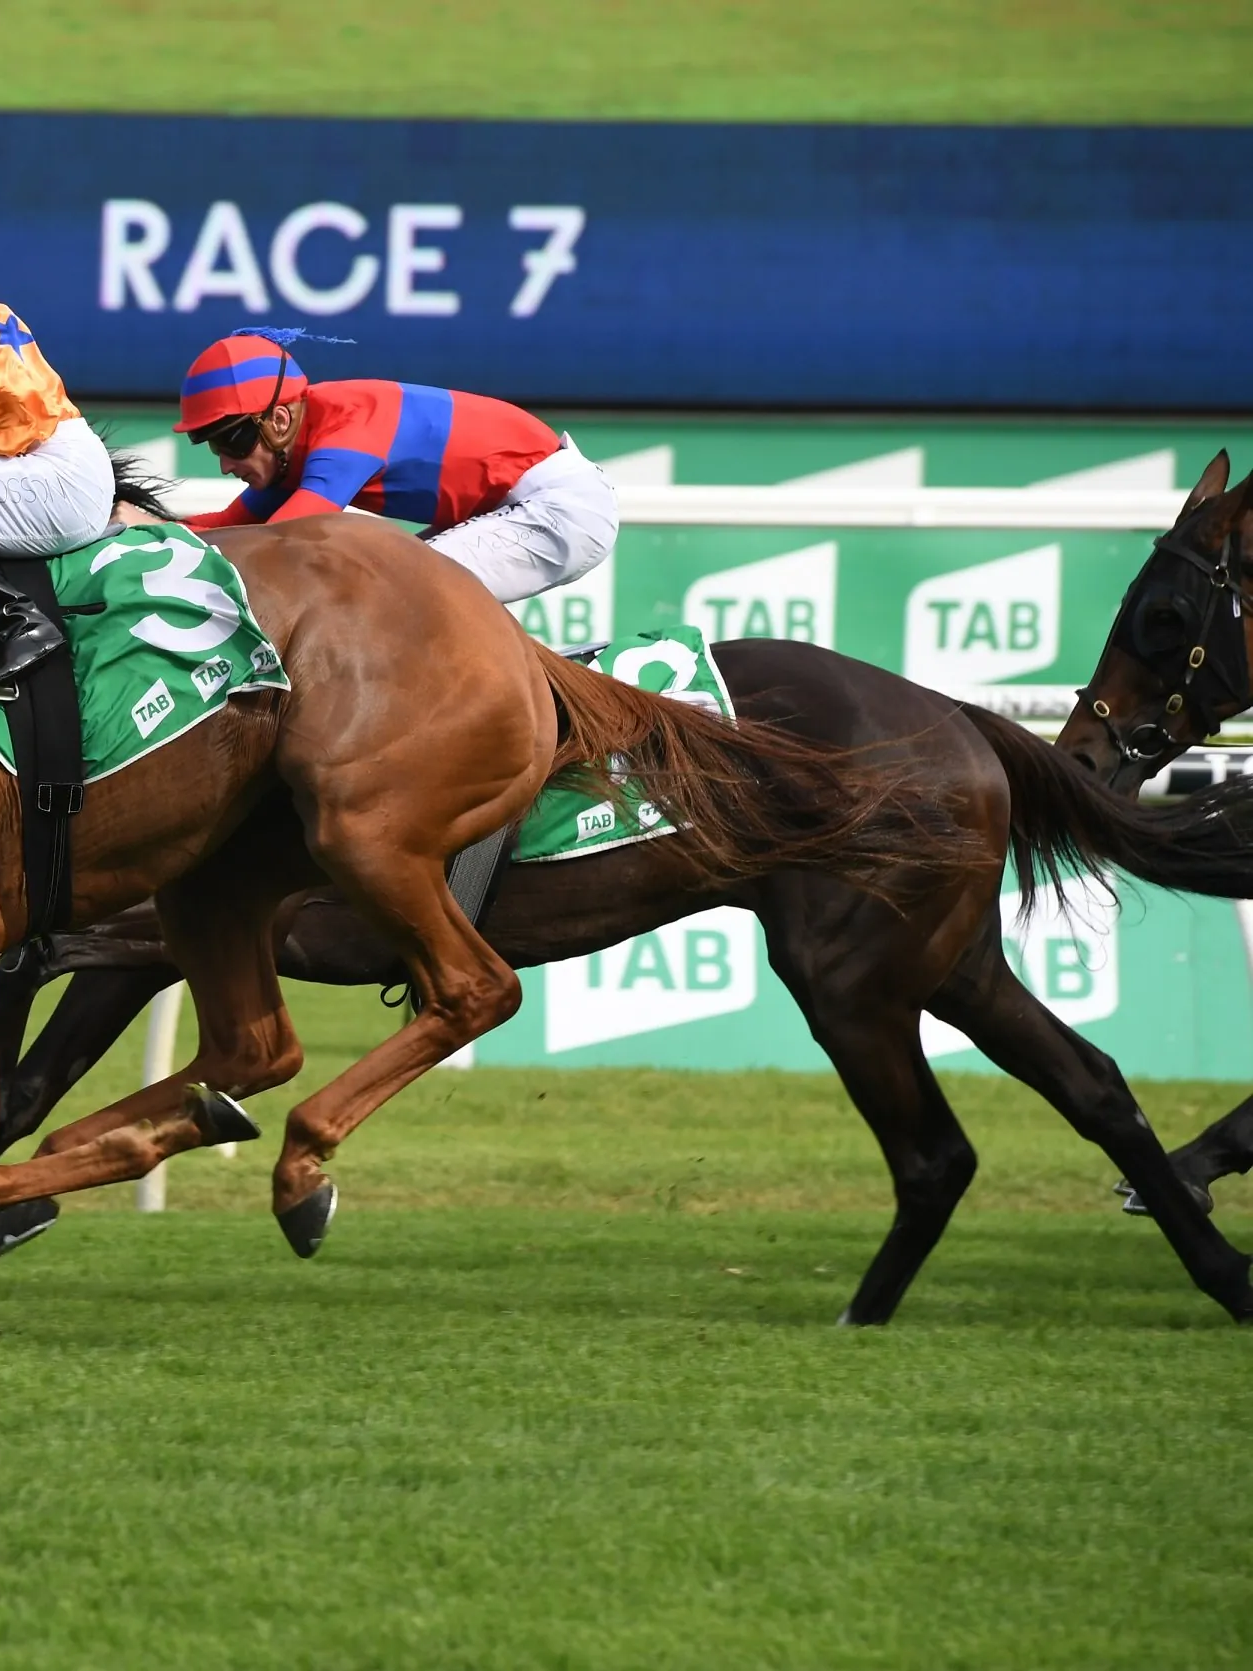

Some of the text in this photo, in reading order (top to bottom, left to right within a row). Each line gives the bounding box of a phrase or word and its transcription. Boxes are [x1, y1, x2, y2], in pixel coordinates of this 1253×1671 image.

[99, 198, 585, 317] RACE 7
[89, 537, 242, 653] 3
[521, 596, 593, 643] AB
[704, 598, 816, 642] TAB
[925, 601, 1042, 651] TAB
[195, 659, 232, 687] TAB
[135, 693, 171, 723] TAB
[581, 812, 612, 831] TAB
